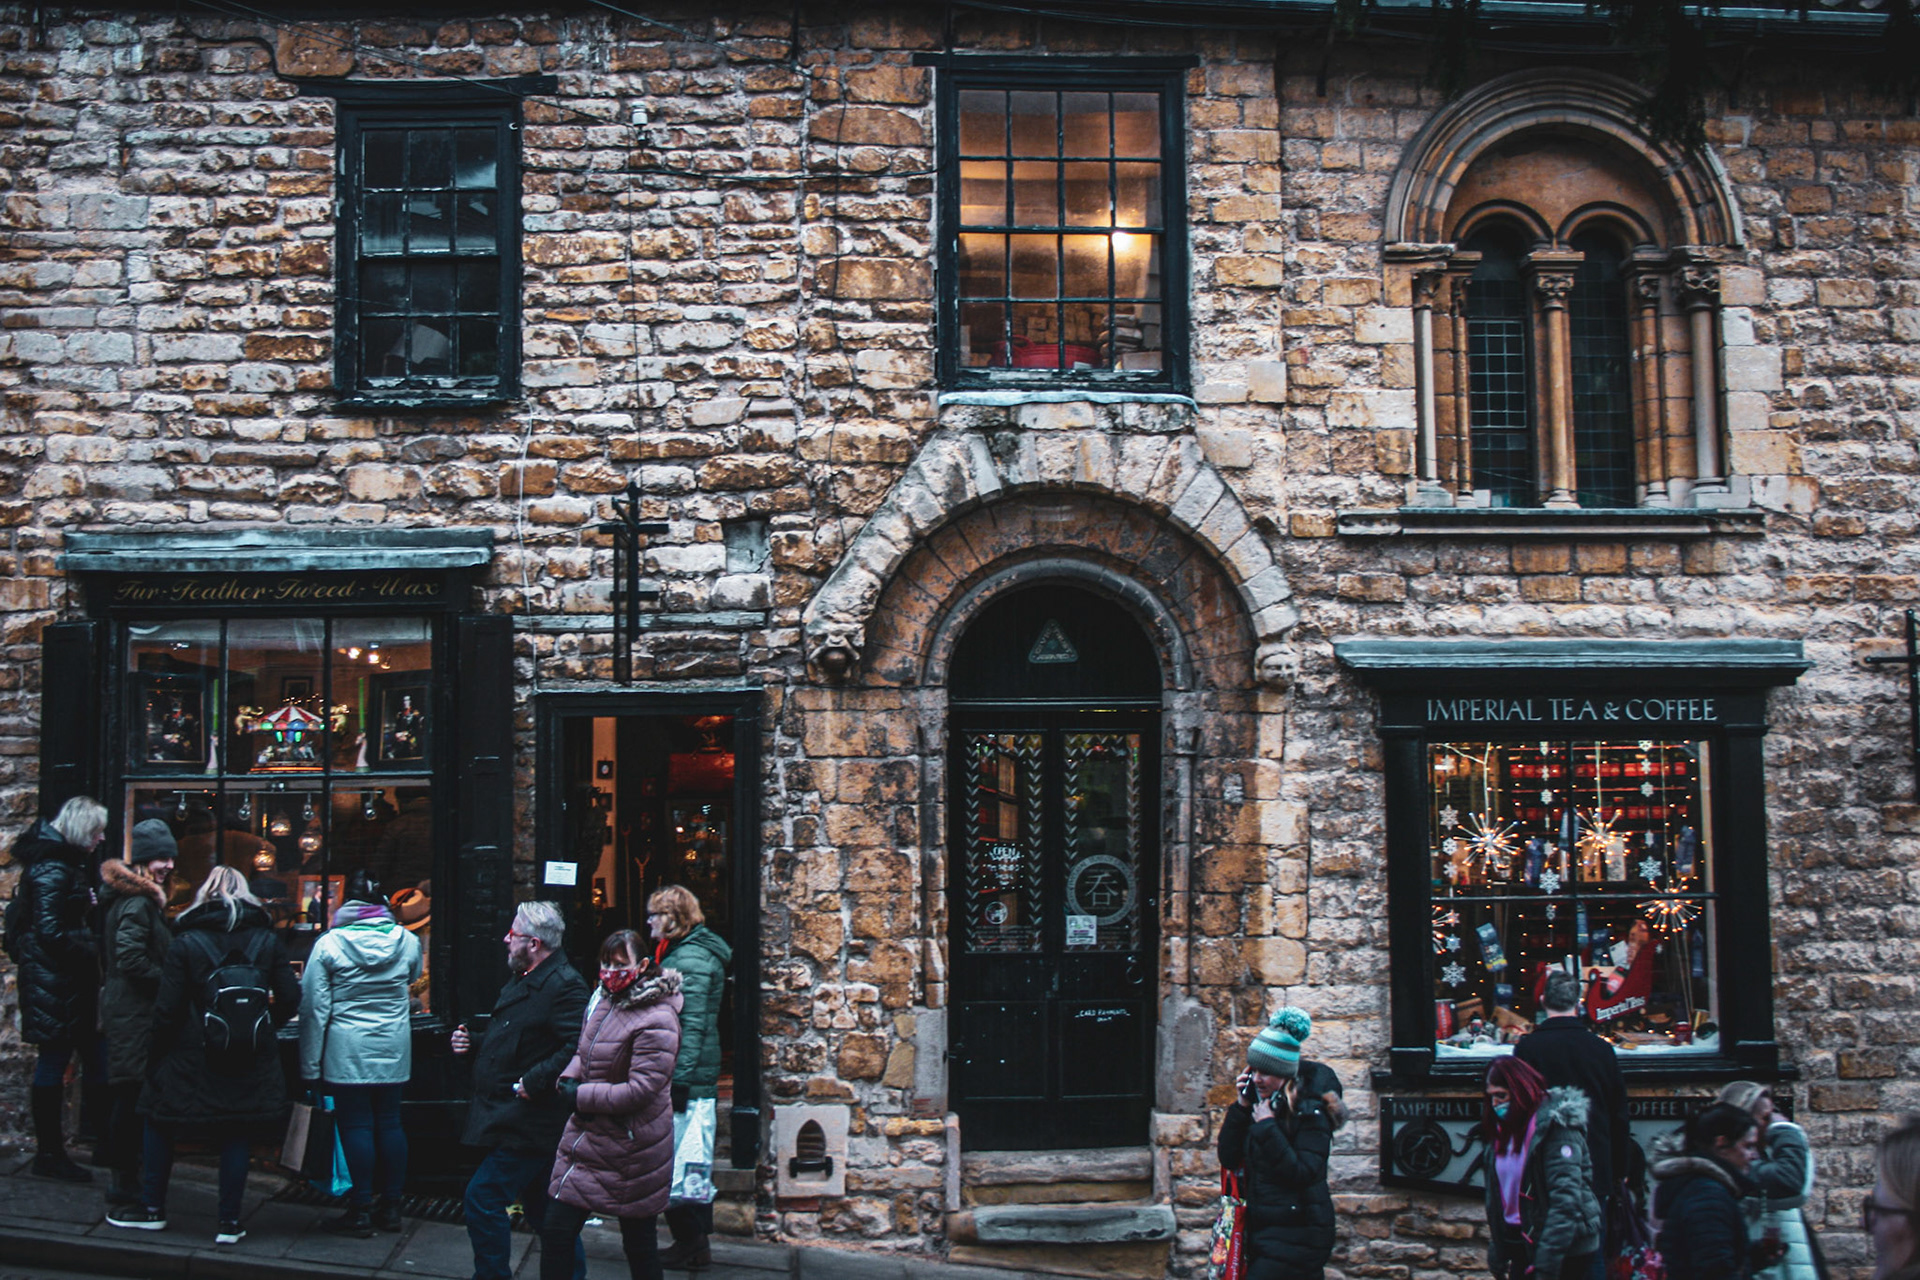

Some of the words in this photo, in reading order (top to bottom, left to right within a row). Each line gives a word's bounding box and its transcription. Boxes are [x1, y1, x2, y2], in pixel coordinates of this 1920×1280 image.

[113, 580, 159, 600] Fur
[170, 578, 266, 601] Feather
[274, 578, 357, 599] Tweed
[372, 574, 440, 596] Wax
[1426, 698, 1542, 721] IMPERIAL
[1547, 698, 1598, 721] TEA
[1602, 701, 1620, 721] &
[1624, 698, 1718, 721] COFFEE
[1392, 1101, 1473, 1117] IMPERIAL
[1627, 1101, 1678, 1117] OFFEE
